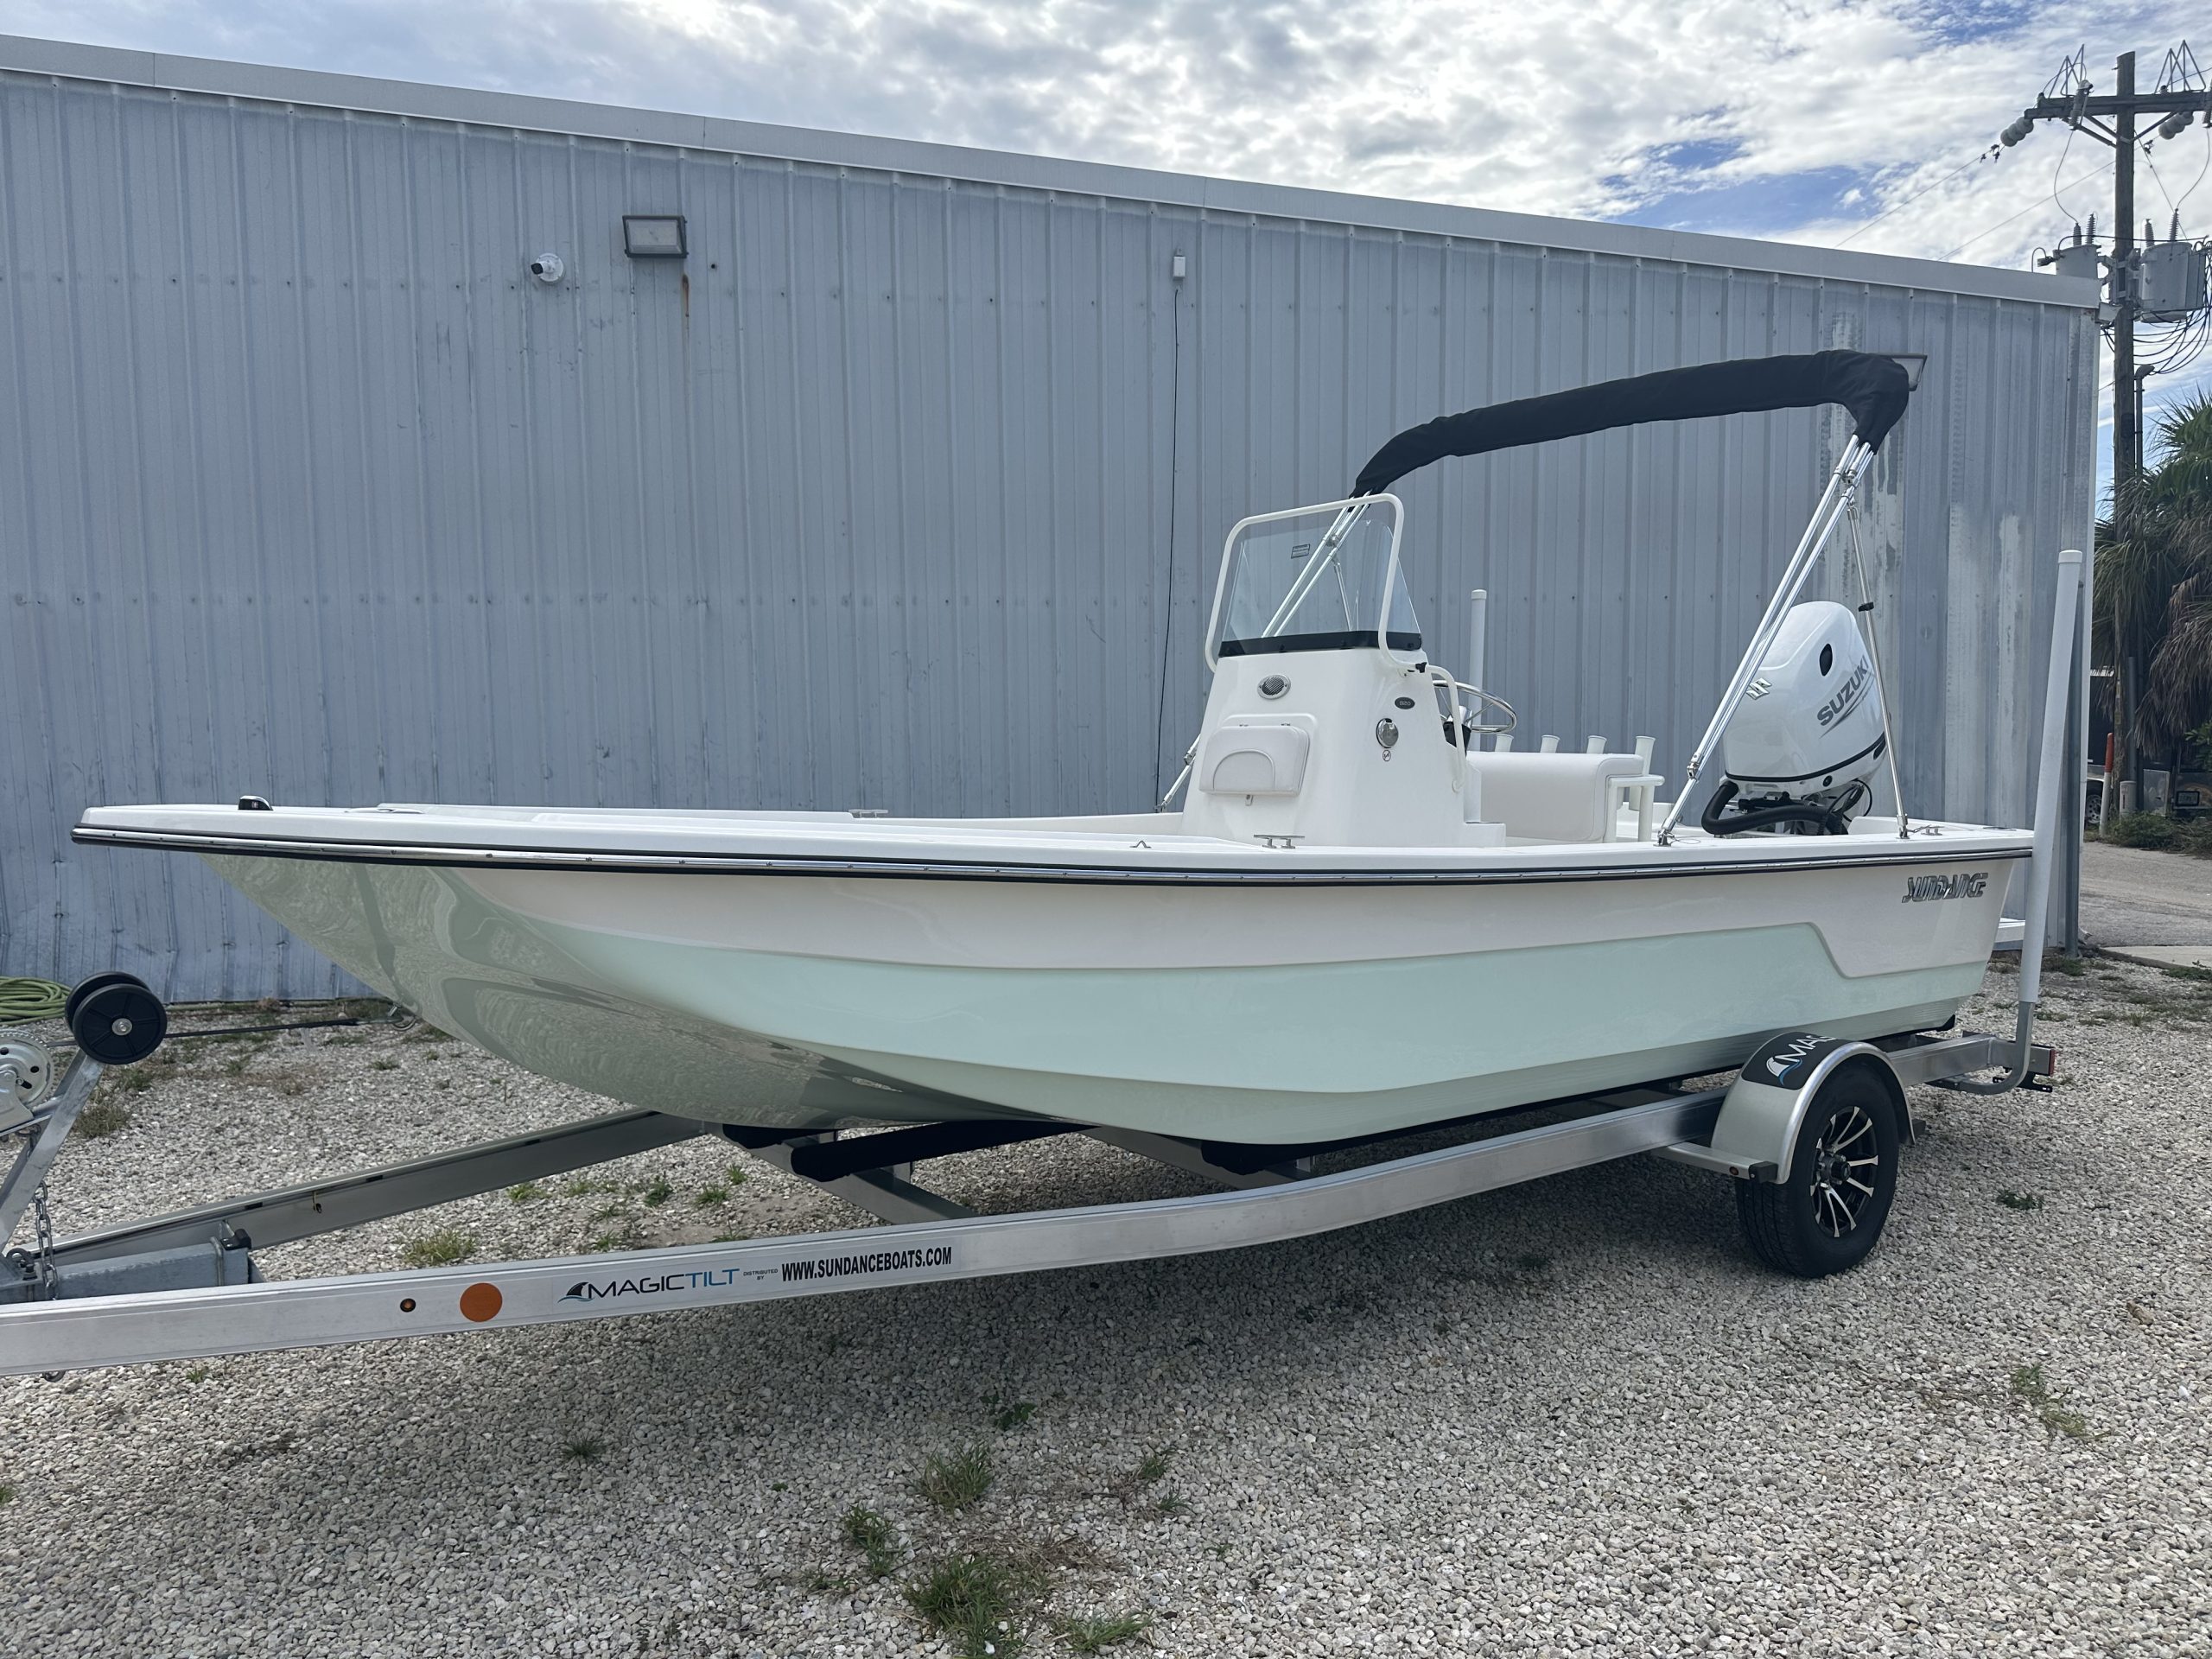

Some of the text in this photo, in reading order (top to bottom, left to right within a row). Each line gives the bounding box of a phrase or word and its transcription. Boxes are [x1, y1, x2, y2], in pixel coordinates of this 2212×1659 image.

[1817, 656, 1869, 726] SUZUKI
[1902, 873, 1988, 903] SUNDANCE
[781, 1246, 952, 1281] WWW.SUNDANCEBOATS.COM
[588, 1268, 740, 1299] MAGICTILT
